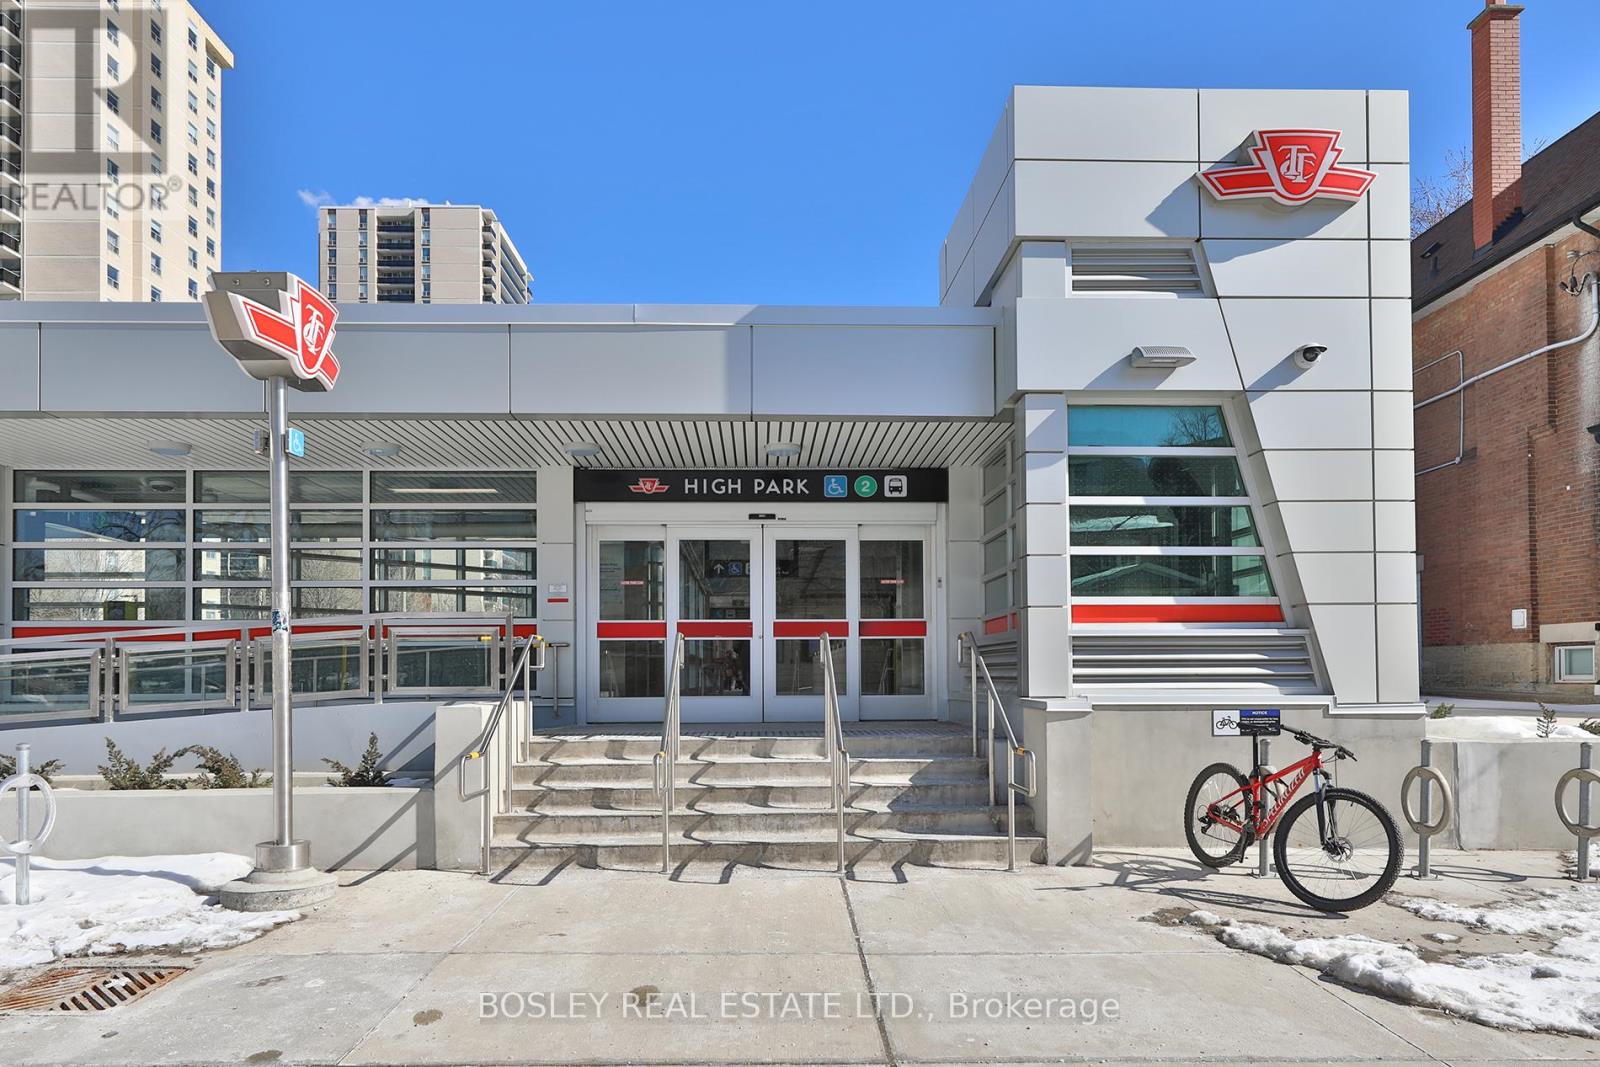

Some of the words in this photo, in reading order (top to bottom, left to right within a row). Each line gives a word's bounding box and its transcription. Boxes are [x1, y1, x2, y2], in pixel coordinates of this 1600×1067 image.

[684, 478, 742, 494] HIGH
[754, 478, 809, 494] PARK
[861, 480, 870, 492] 2
